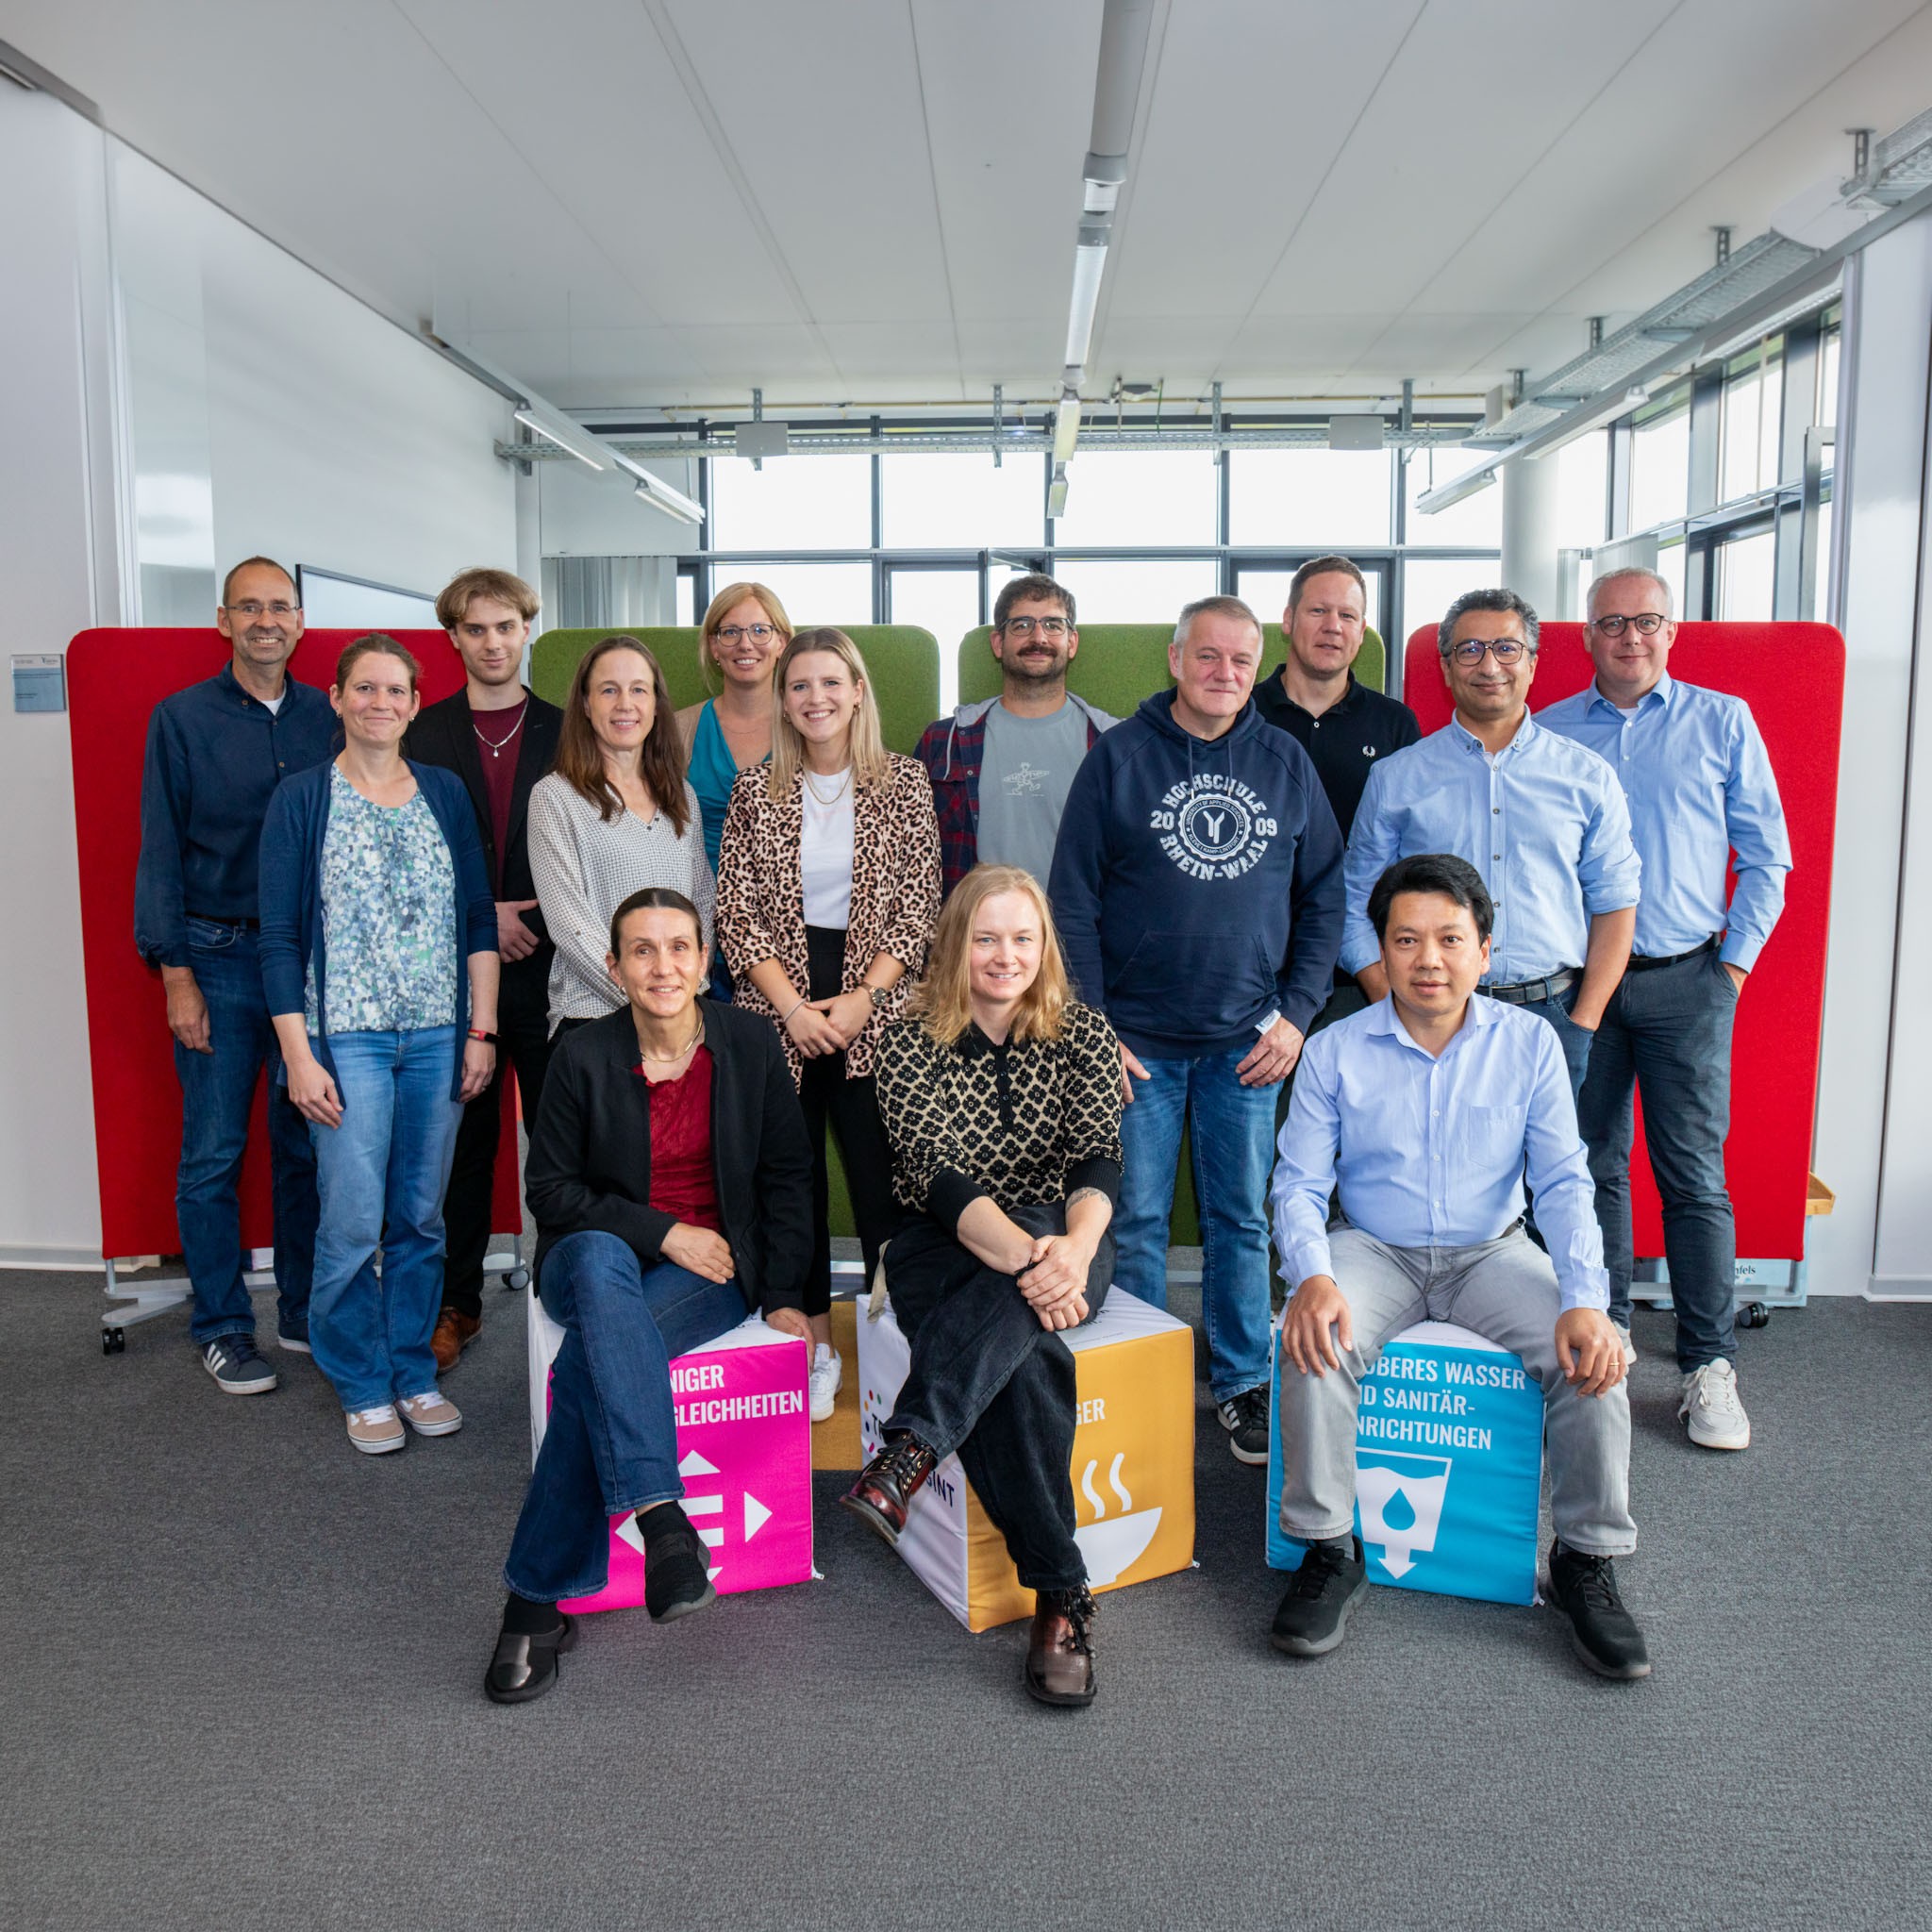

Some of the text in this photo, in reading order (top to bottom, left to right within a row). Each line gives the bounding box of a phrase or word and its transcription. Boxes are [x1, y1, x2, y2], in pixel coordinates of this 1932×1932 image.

[1162, 773, 1267, 814] HOCHSCHULE
[1150, 809, 1175, 831] 20
[1185, 801, 1203, 825] UNIVERSITY
[1208, 799, 1231, 808] APPLIED
[1229, 805, 1245, 828] SCIENCES
[1255, 817, 1278, 837] 09
[1159, 833, 1269, 881] RHEIN-WAAL
[1445, 1361, 1526, 1391] WASSER
[1383, 1387, 1475, 1416] SANITÄR-
